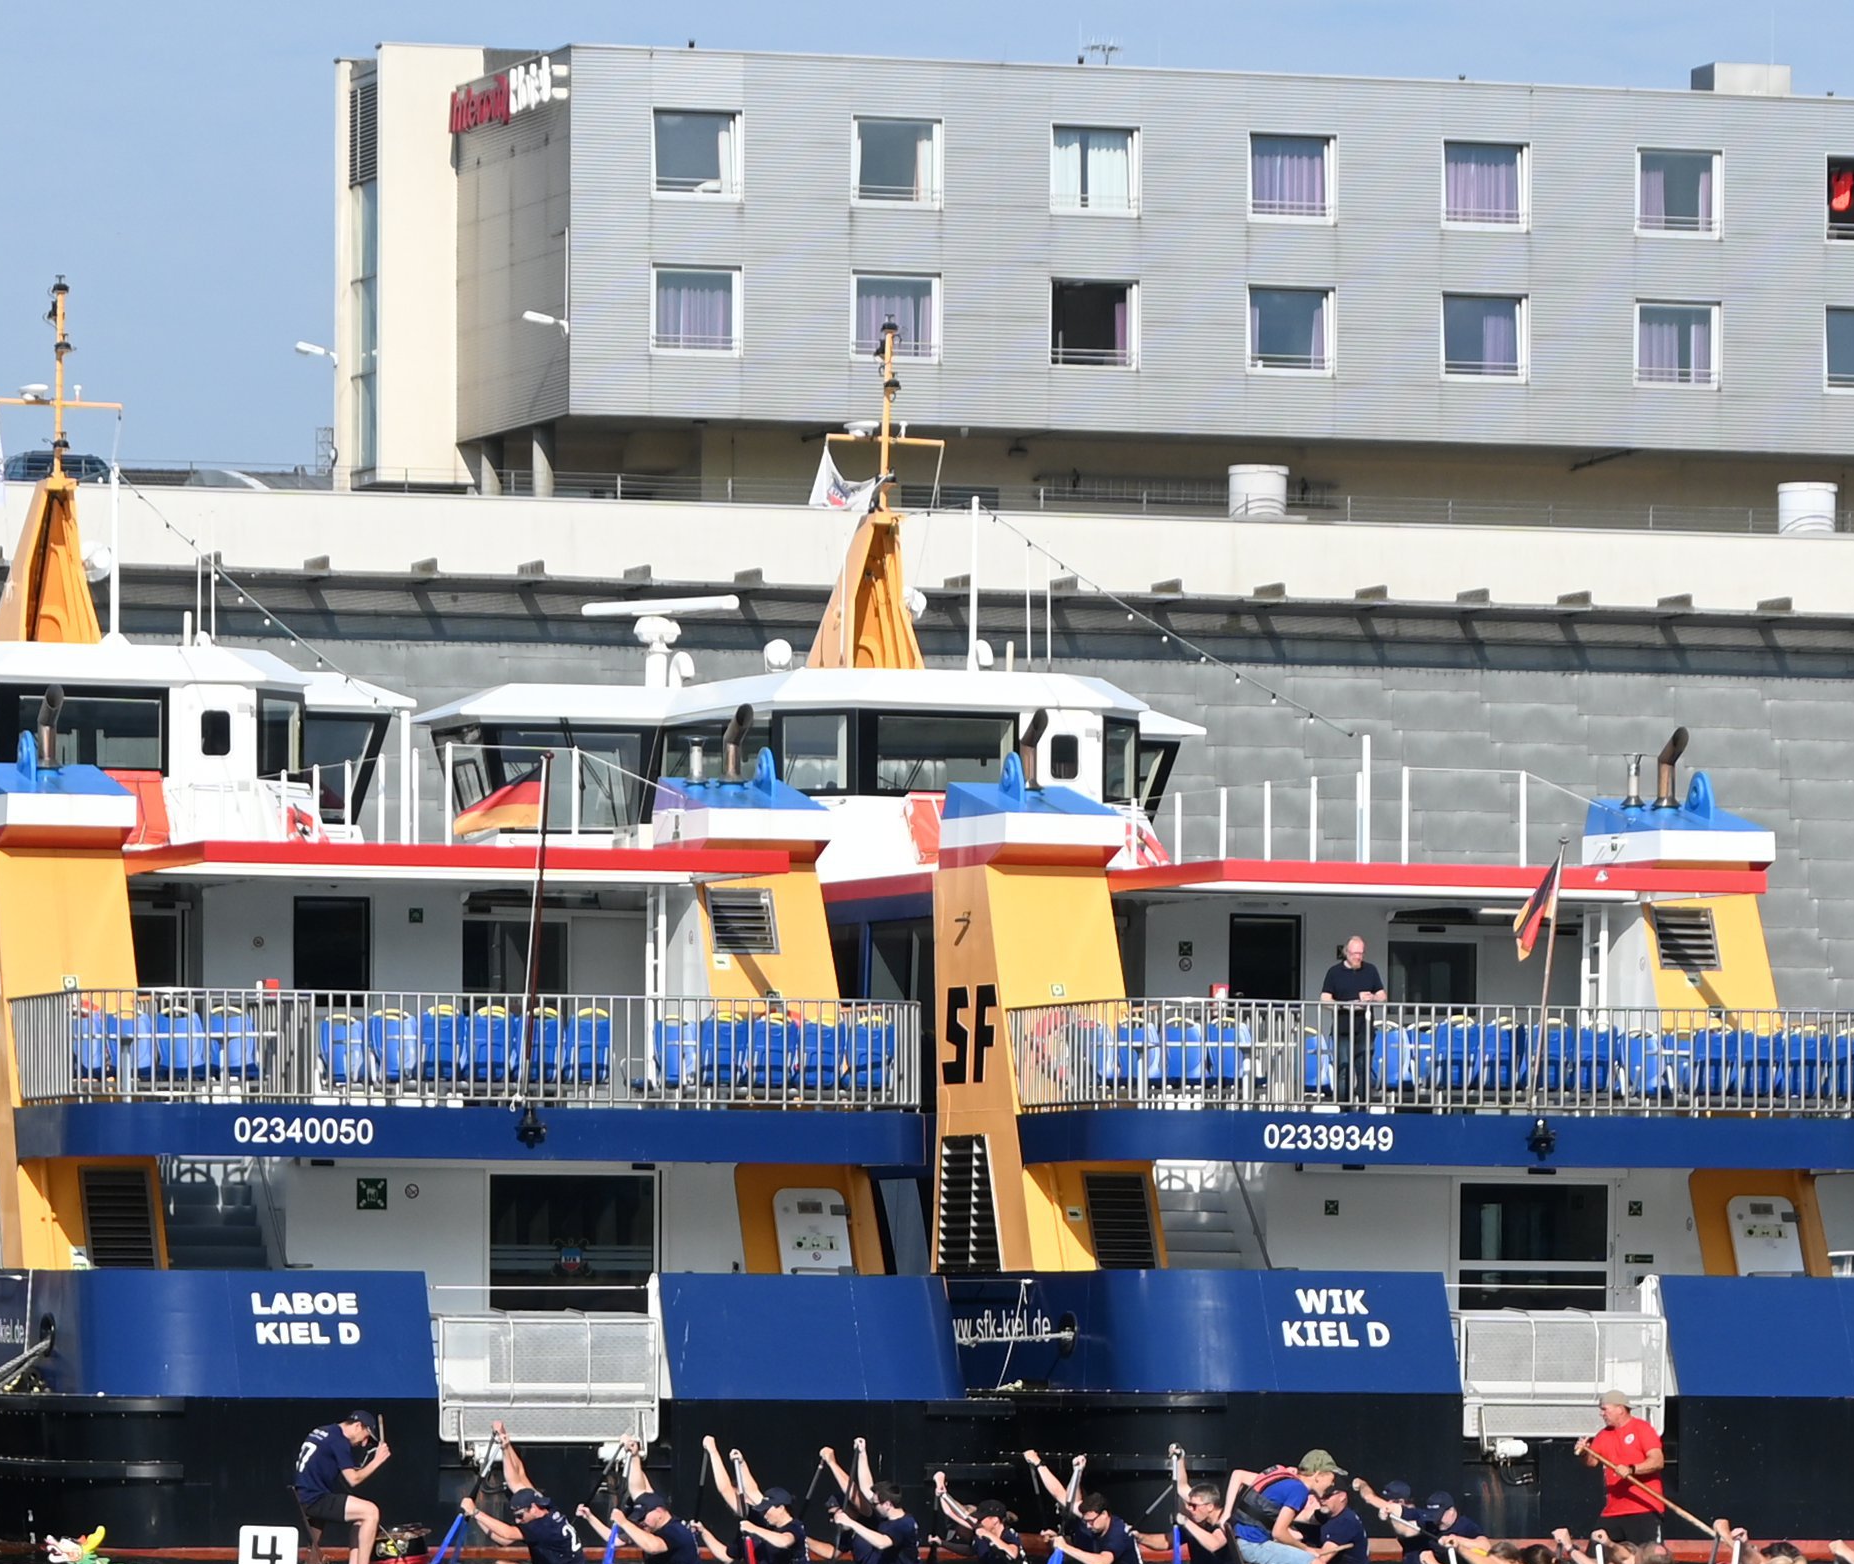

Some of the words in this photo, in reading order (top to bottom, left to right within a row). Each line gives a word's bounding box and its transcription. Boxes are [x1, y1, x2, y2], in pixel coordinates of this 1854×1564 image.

[942, 984, 998, 1086] SF
[233, 1116, 375, 1145] 02340050
[1263, 1123, 1395, 1152] 02339349
[251, 1292, 359, 1316] LABOE
[1295, 1288, 1369, 1315] WIK
[255, 1322, 331, 1345] KIEL
[338, 1322, 361, 1345] D
[1281, 1320, 1360, 1347] KIEL
[1366, 1321, 1391, 1347] D
